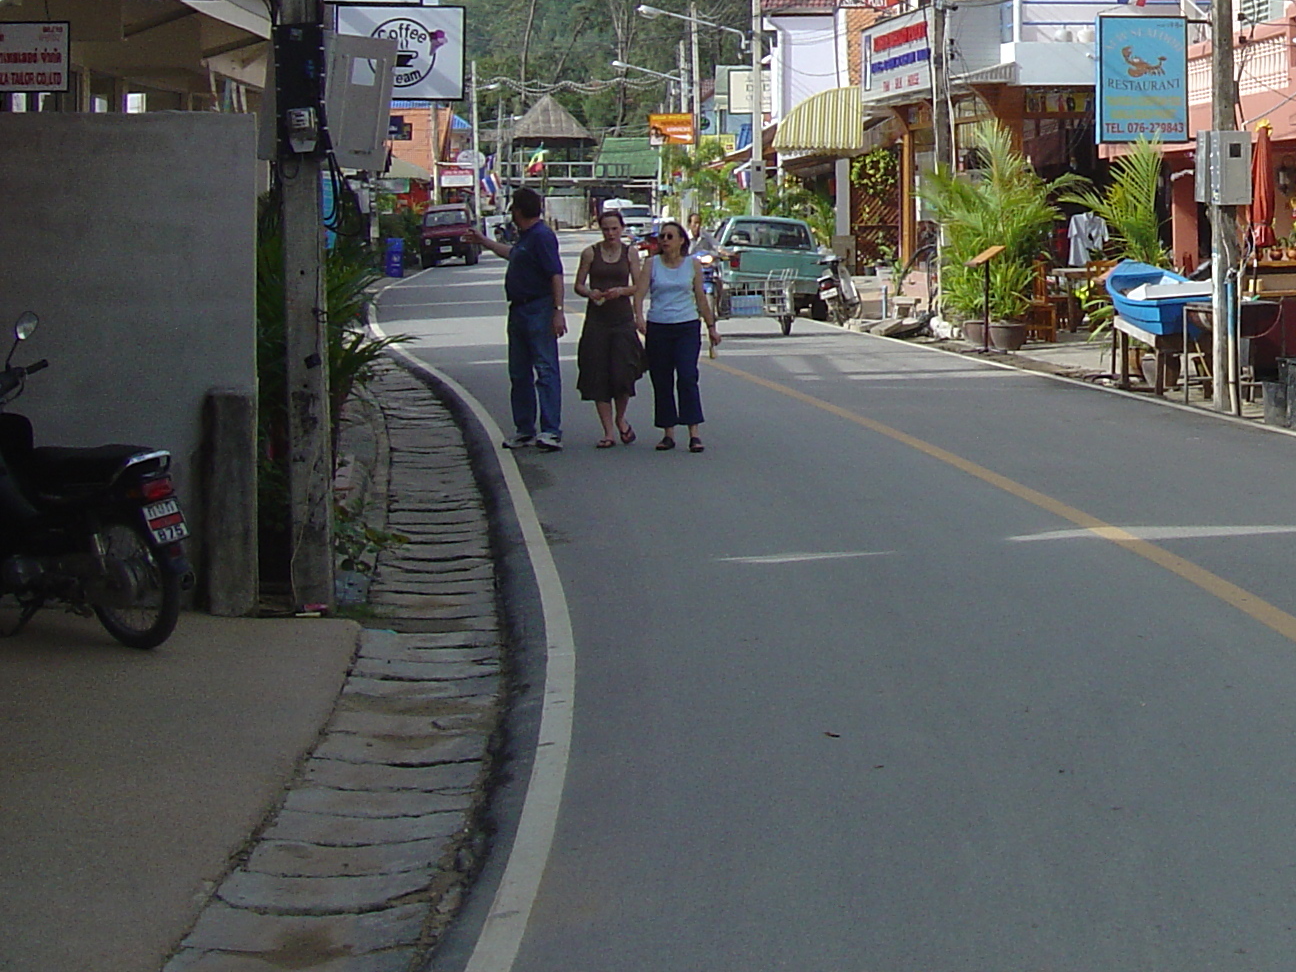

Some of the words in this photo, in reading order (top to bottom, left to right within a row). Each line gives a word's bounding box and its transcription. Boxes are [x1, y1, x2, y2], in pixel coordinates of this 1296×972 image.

[11, 72, 35, 86] TAILOR
[1108, 78, 1180, 91] RESTAURANT
[1105, 122, 1125, 133] TEL.
